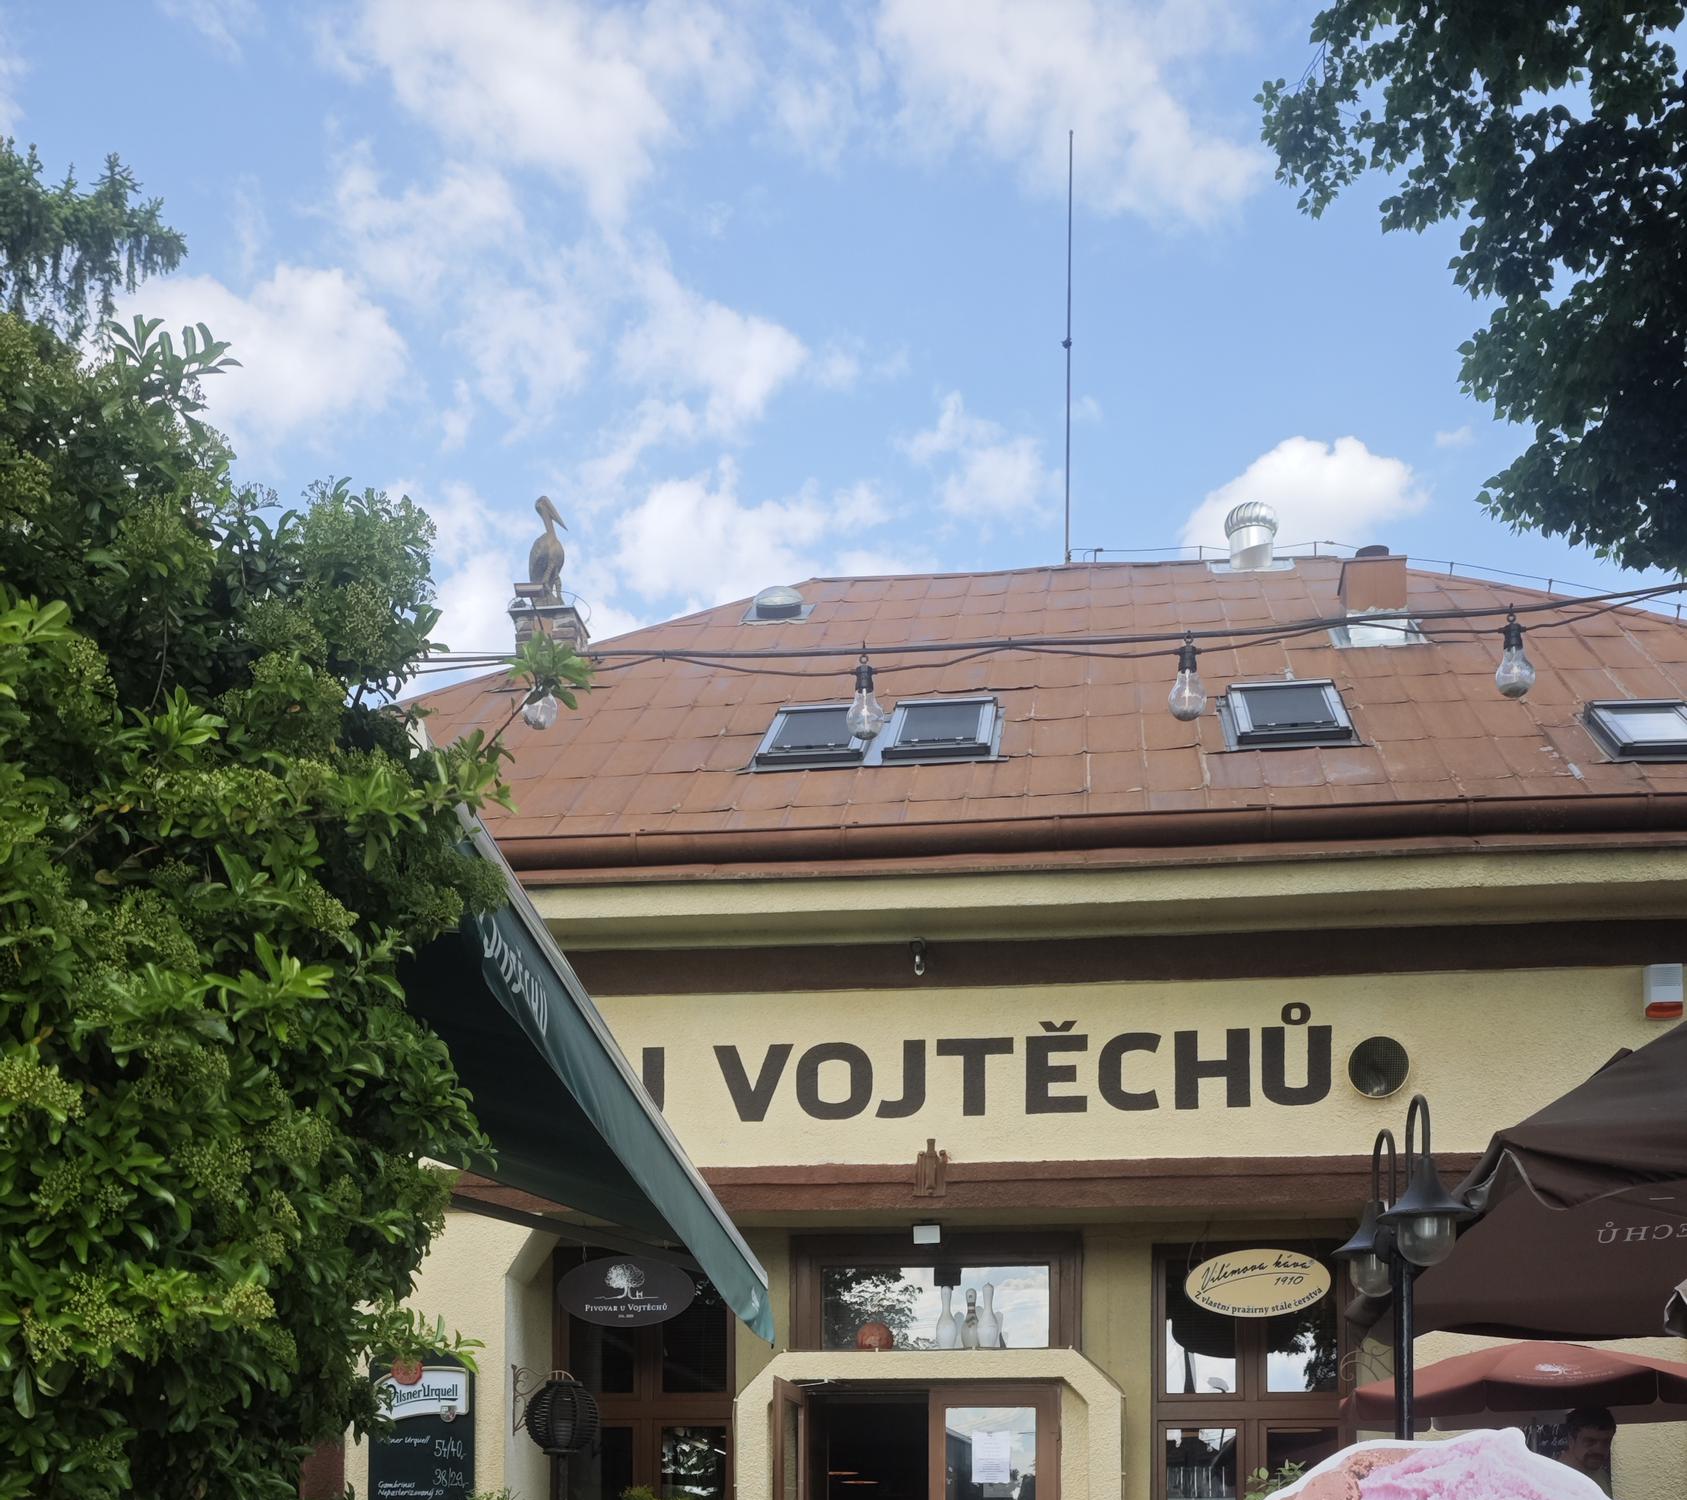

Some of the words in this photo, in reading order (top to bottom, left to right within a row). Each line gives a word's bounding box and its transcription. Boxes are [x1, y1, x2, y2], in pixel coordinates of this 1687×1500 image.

[714, 1002, 1333, 1122] VOJTĚCHŮ
[1201, 1262, 1268, 1291] Vilémova
[1274, 1276, 1303, 1286] 1910
[1202, 1296, 1230, 1312] vlastní
[1271, 1300, 1292, 1313] stále
[1293, 1286, 1323, 1307] čerstvá
[421, 1383, 458, 1402] Urquell
